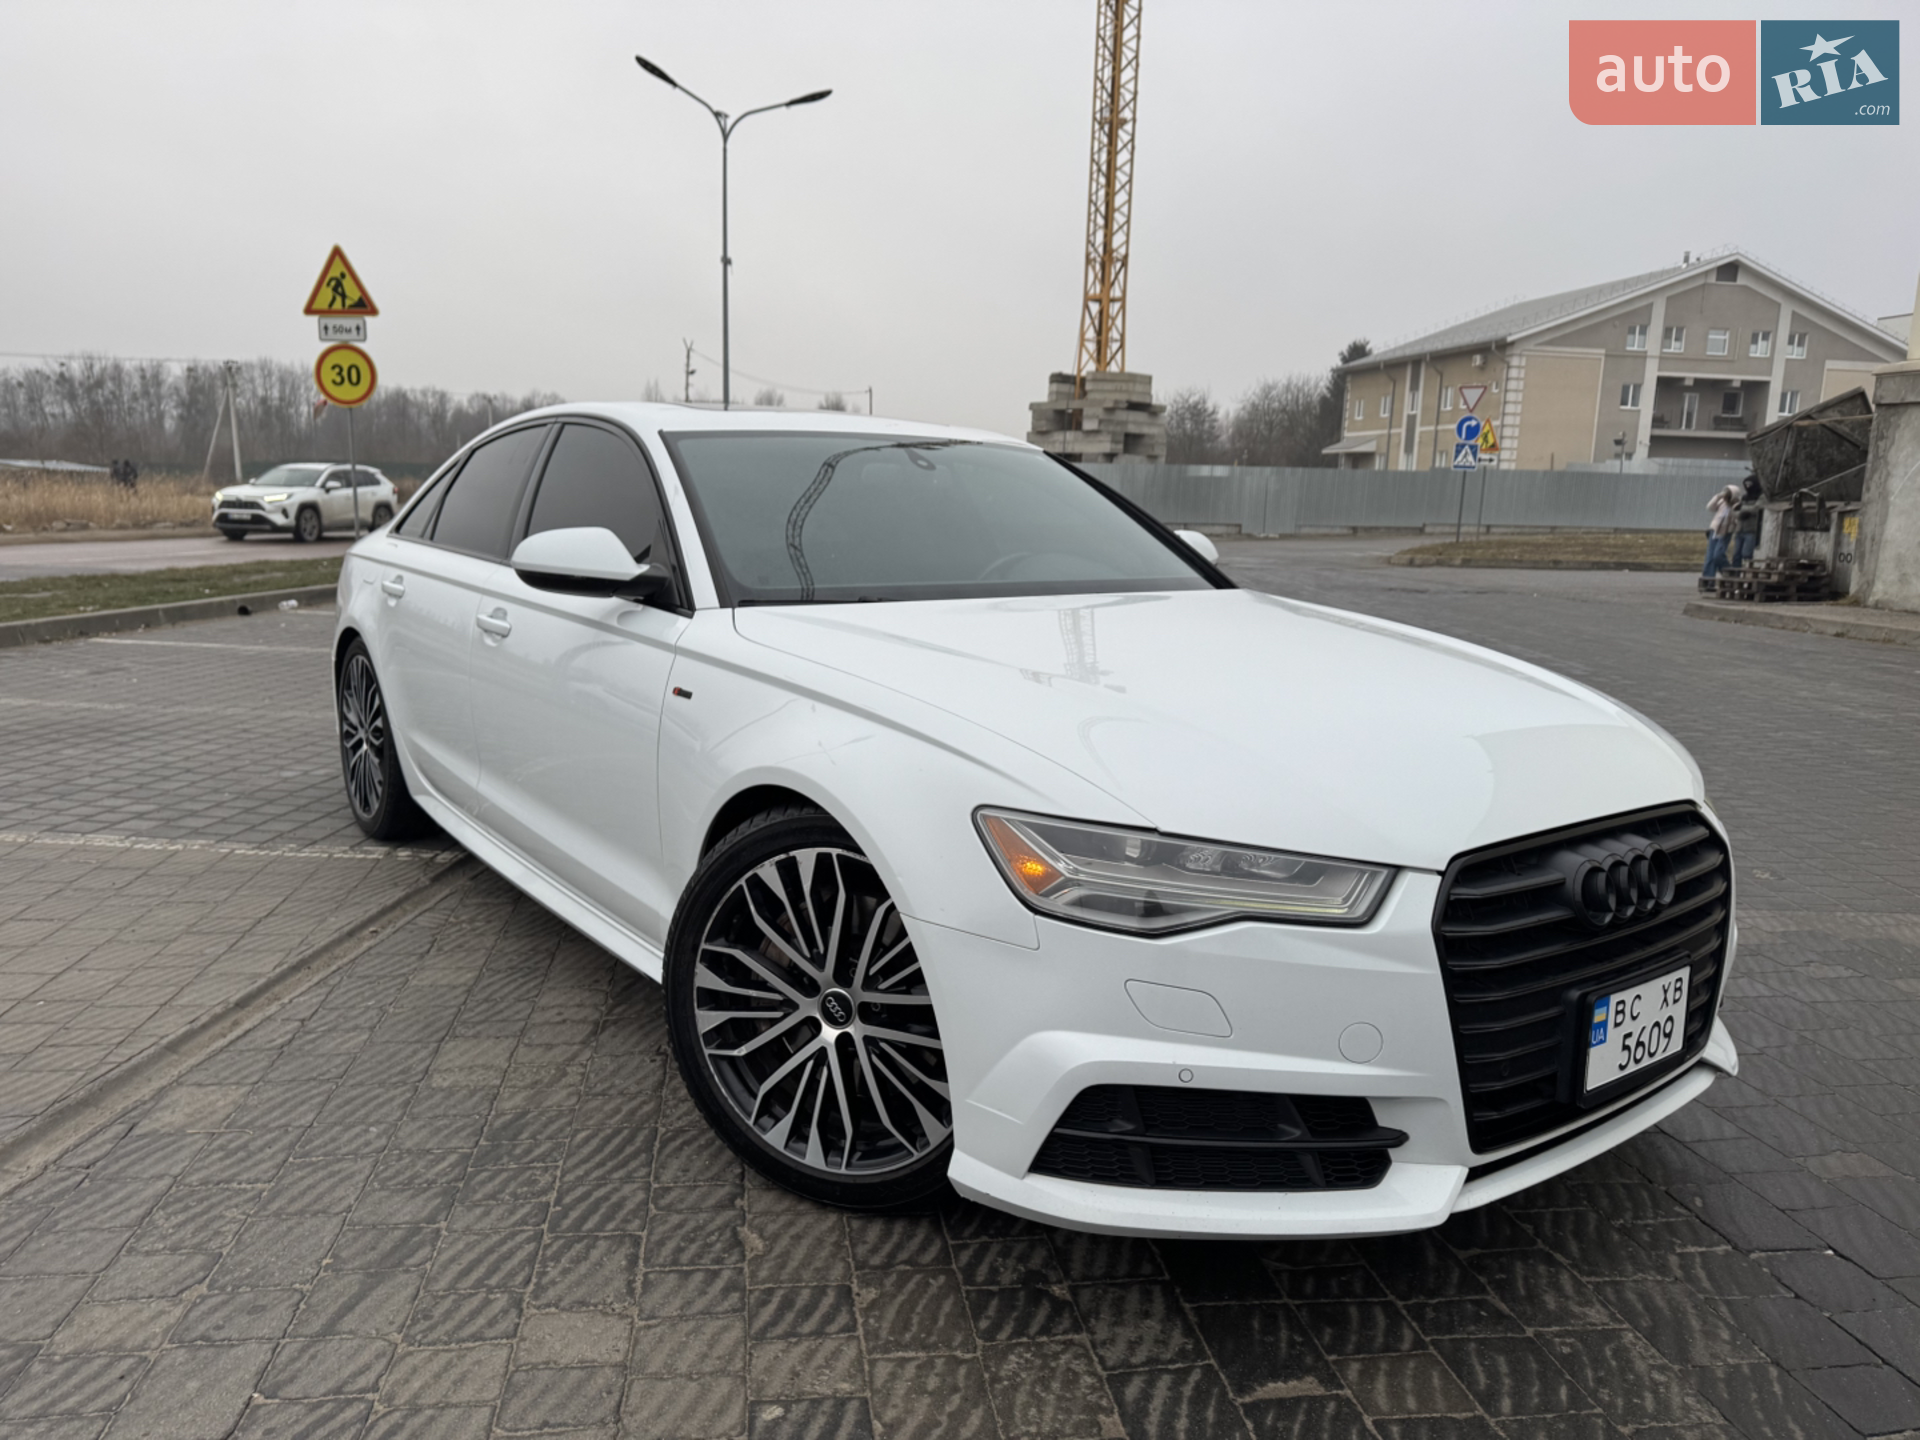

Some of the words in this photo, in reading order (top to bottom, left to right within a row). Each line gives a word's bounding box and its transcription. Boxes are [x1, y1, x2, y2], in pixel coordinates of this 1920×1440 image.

[330, 363, 362, 387] 30
[1613, 994, 1642, 1029] BC
[1660, 977, 1684, 1011] XB
[1591, 1027, 1605, 1044] UA
[1618, 1015, 1675, 1071] 5609
